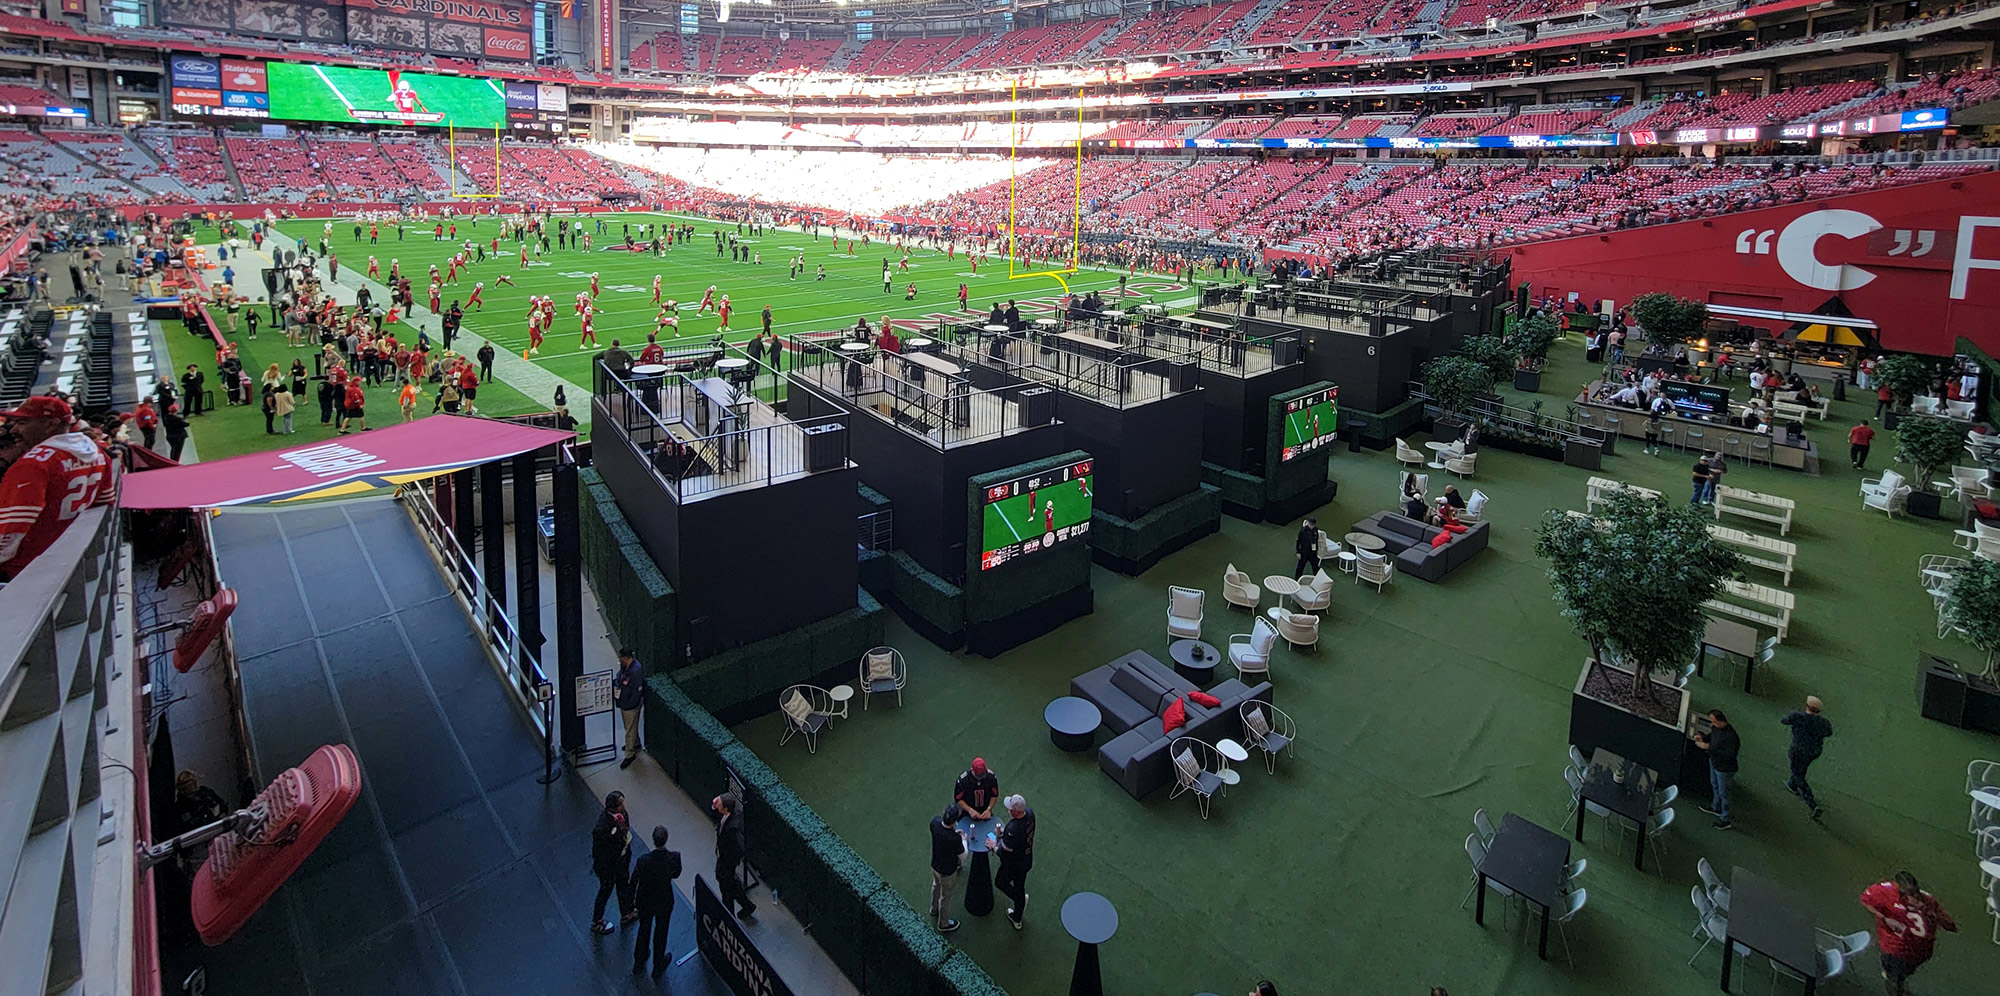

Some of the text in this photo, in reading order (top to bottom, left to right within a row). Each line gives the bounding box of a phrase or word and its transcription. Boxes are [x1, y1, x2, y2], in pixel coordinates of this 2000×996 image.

[374, 0, 522, 24] CARDINALS
[1695, 17, 1718, 27] ADRIAN
[1720, 11, 1746, 21] WILSON
[182, 62, 209, 72] Ford
[224, 64, 265, 75] State Farm
[1821, 125, 1838, 134] SACK
[1855, 122, 1867, 131] TFL
[1679, 129, 1707, 137] SEASON
[1783, 128, 1806, 136] SOLO
[859, 331, 865, 339] 11
[1367, 346, 1376, 356] 6
[653, 353, 660, 363] 6
[23, 447, 57, 462] 23
[1013, 481, 1019, 496] 0
[1063, 468, 1069, 482] 0
[1071, 522, 1090, 538] $21,277
[973, 789, 985, 808] 11
[719, 920, 774, 996] ARIZONA
